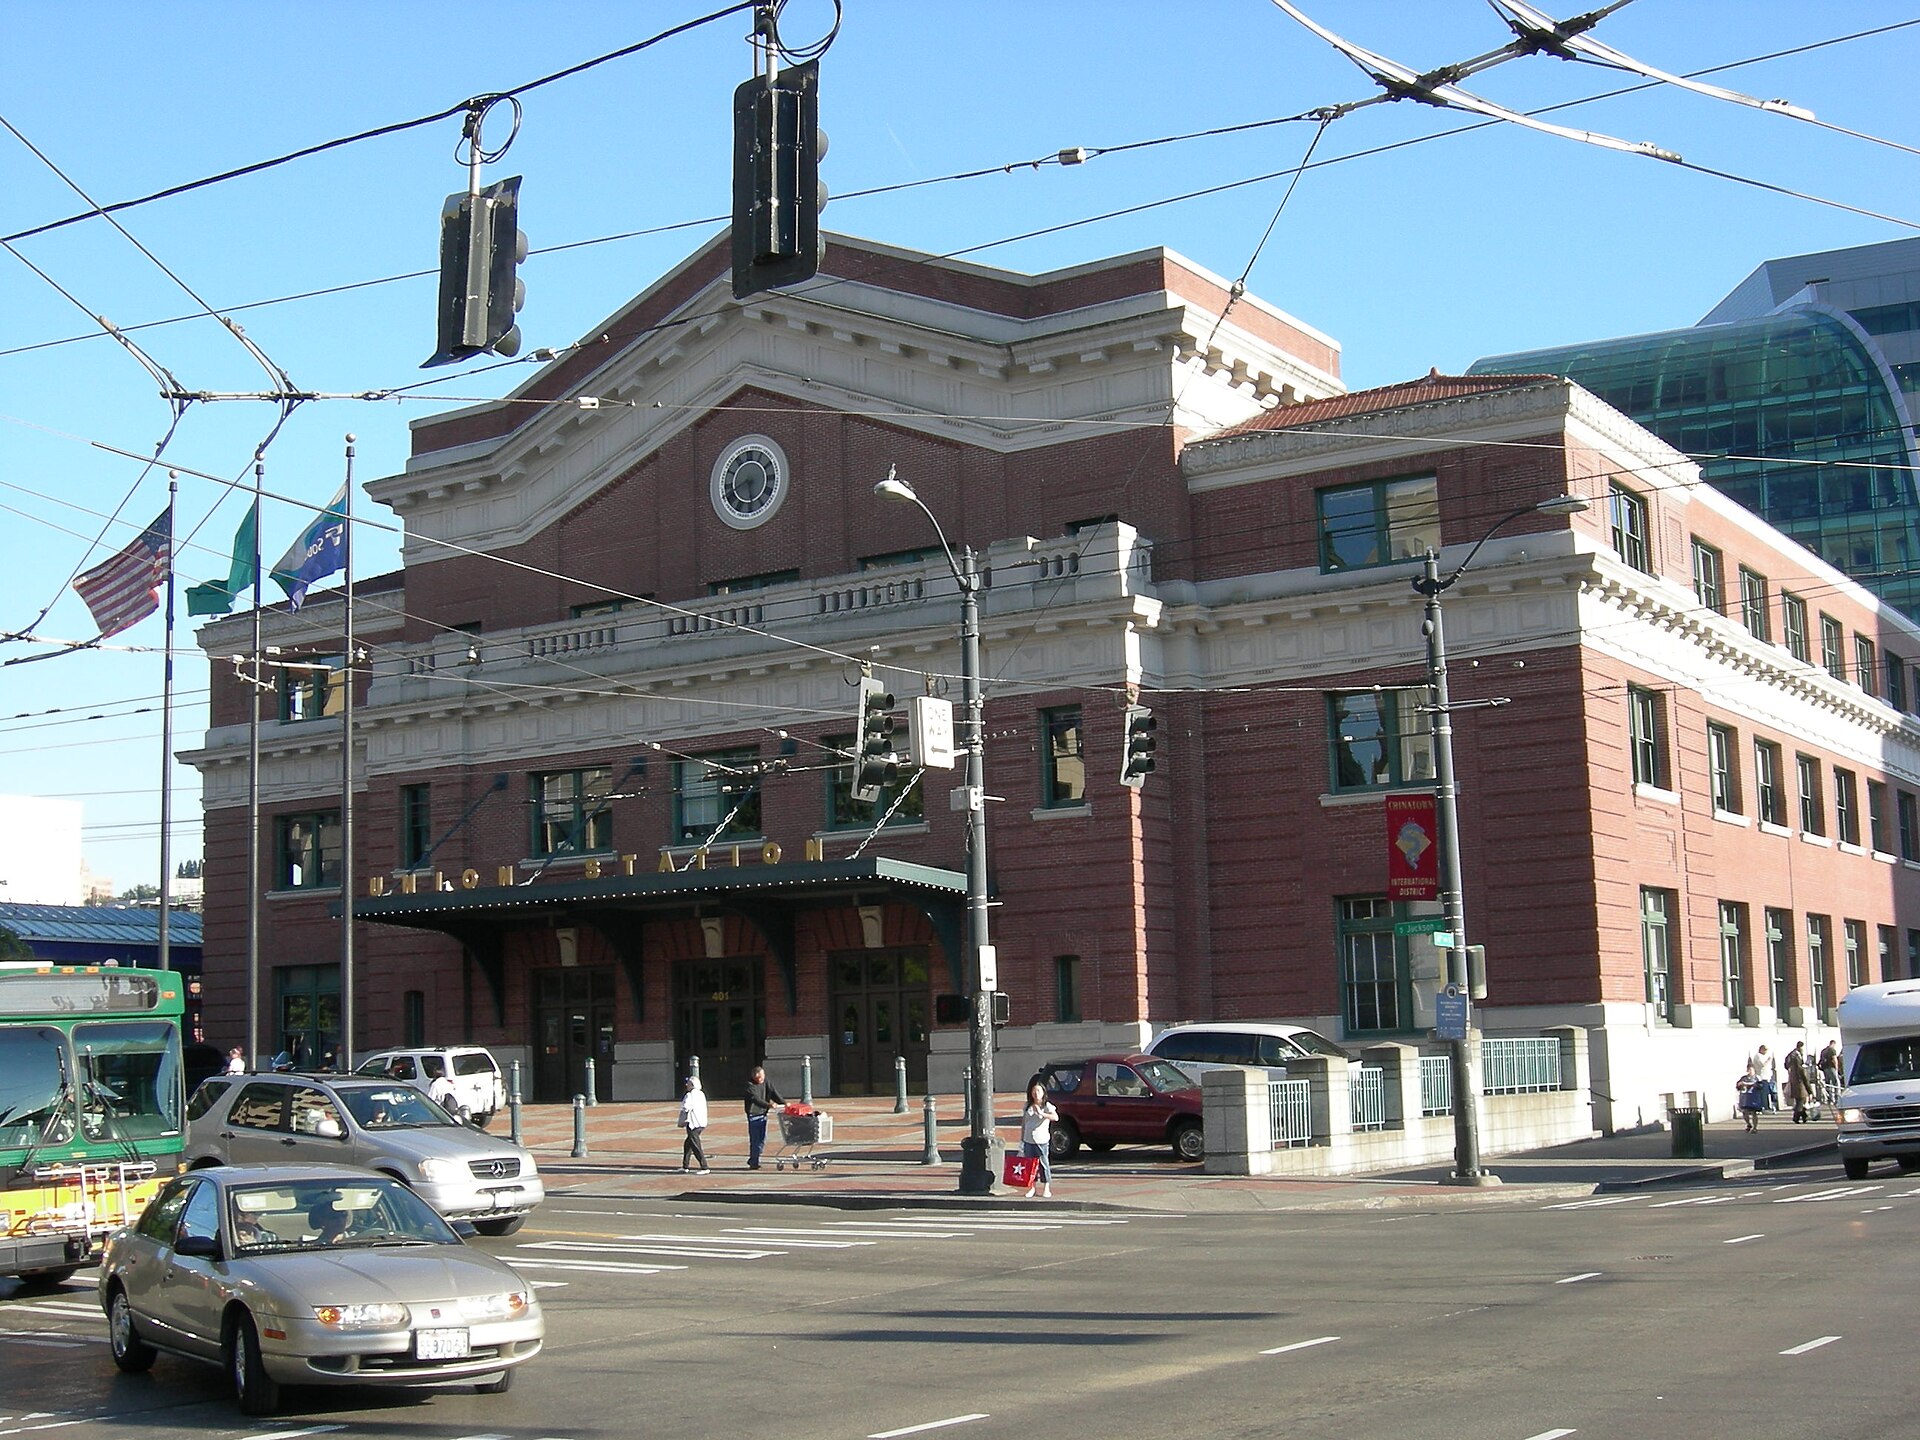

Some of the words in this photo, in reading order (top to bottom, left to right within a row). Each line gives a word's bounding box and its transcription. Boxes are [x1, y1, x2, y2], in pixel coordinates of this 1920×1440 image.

[928, 706, 948, 722] ONE
[928, 725, 950, 737] WAY
[1388, 800, 1434, 810] CHINATOWN
[369, 865, 514, 897] UNION
[584, 837, 824, 880] STATION
[1391, 877, 1436, 886] INTERNATIONAL
[1399, 887, 1426, 896] DISTRICT
[712, 991, 729, 1001] 401
